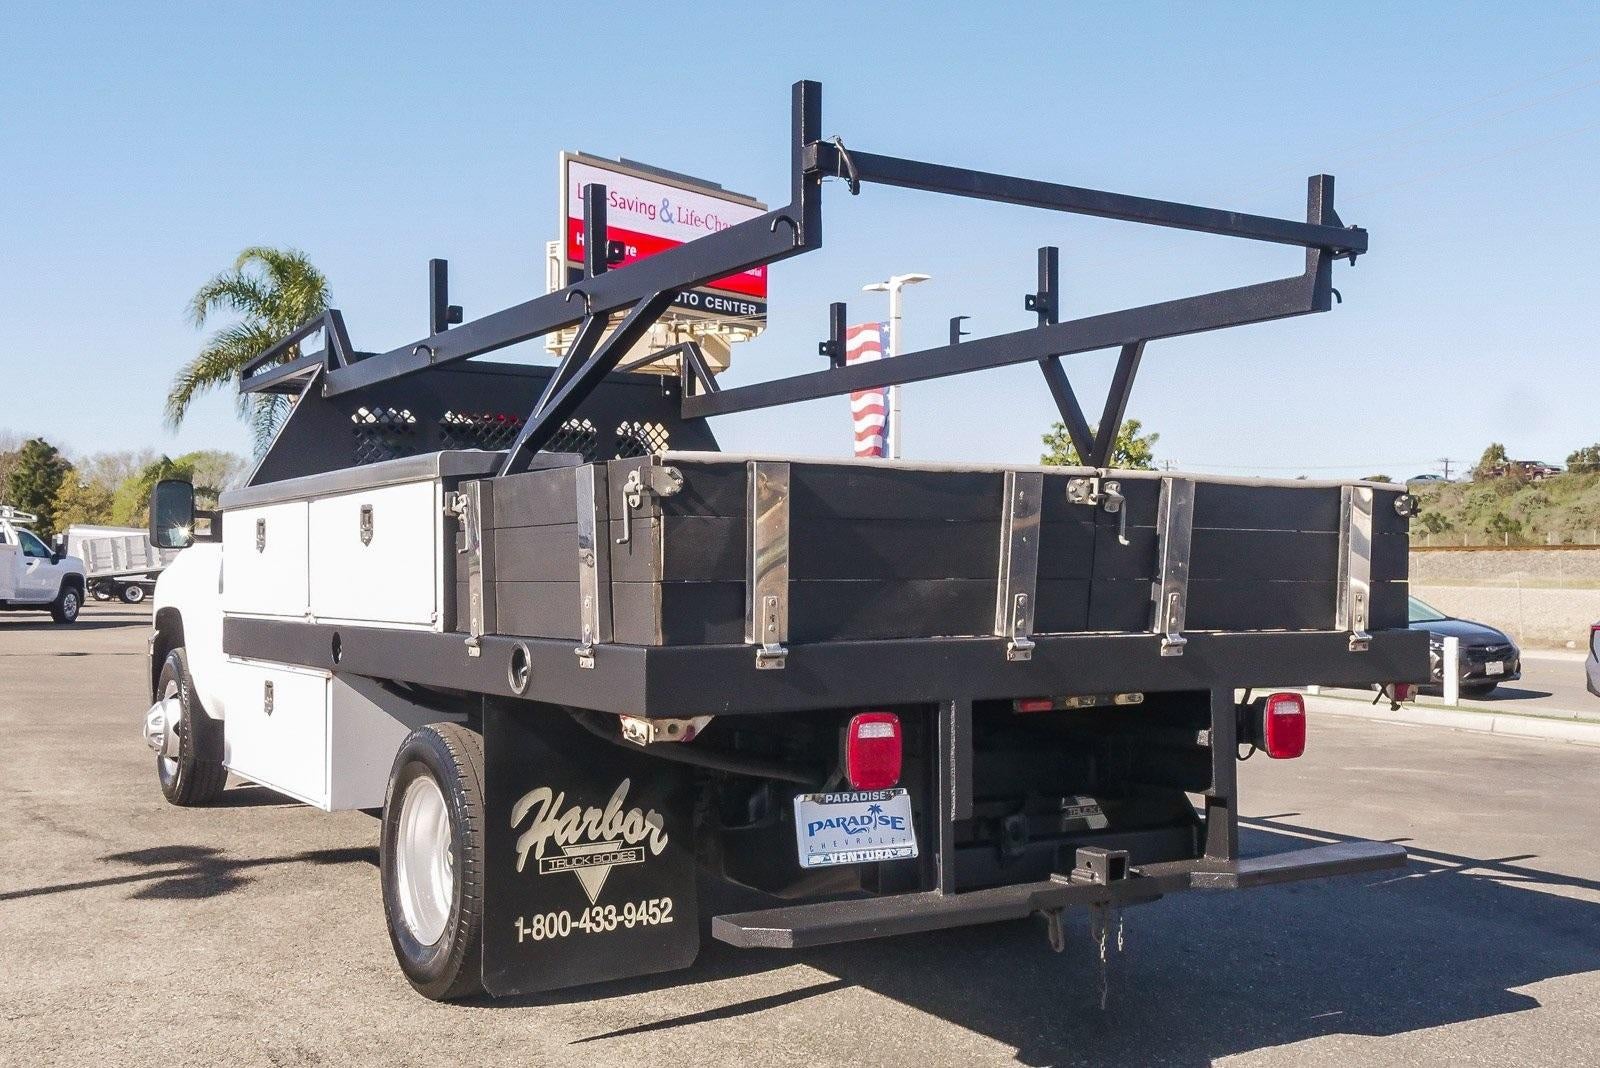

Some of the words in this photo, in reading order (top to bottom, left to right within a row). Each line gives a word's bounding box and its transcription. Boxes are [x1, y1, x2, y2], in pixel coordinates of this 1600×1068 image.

[578, 183, 656, 220] L-Saving
[660, 198, 674, 223] &
[705, 296, 756, 315] CENTER
[826, 791, 886, 803] PARADISE
[511, 778, 669, 873] Harbor
[808, 804, 906, 837] PARADISE
[809, 838, 907, 852] CHEVROLET
[549, 856, 591, 870] TRUCK
[593, 850, 636, 864] BODIES
[829, 848, 895, 863] VENTURA
[515, 897, 673, 943] 1-800-433-9452
